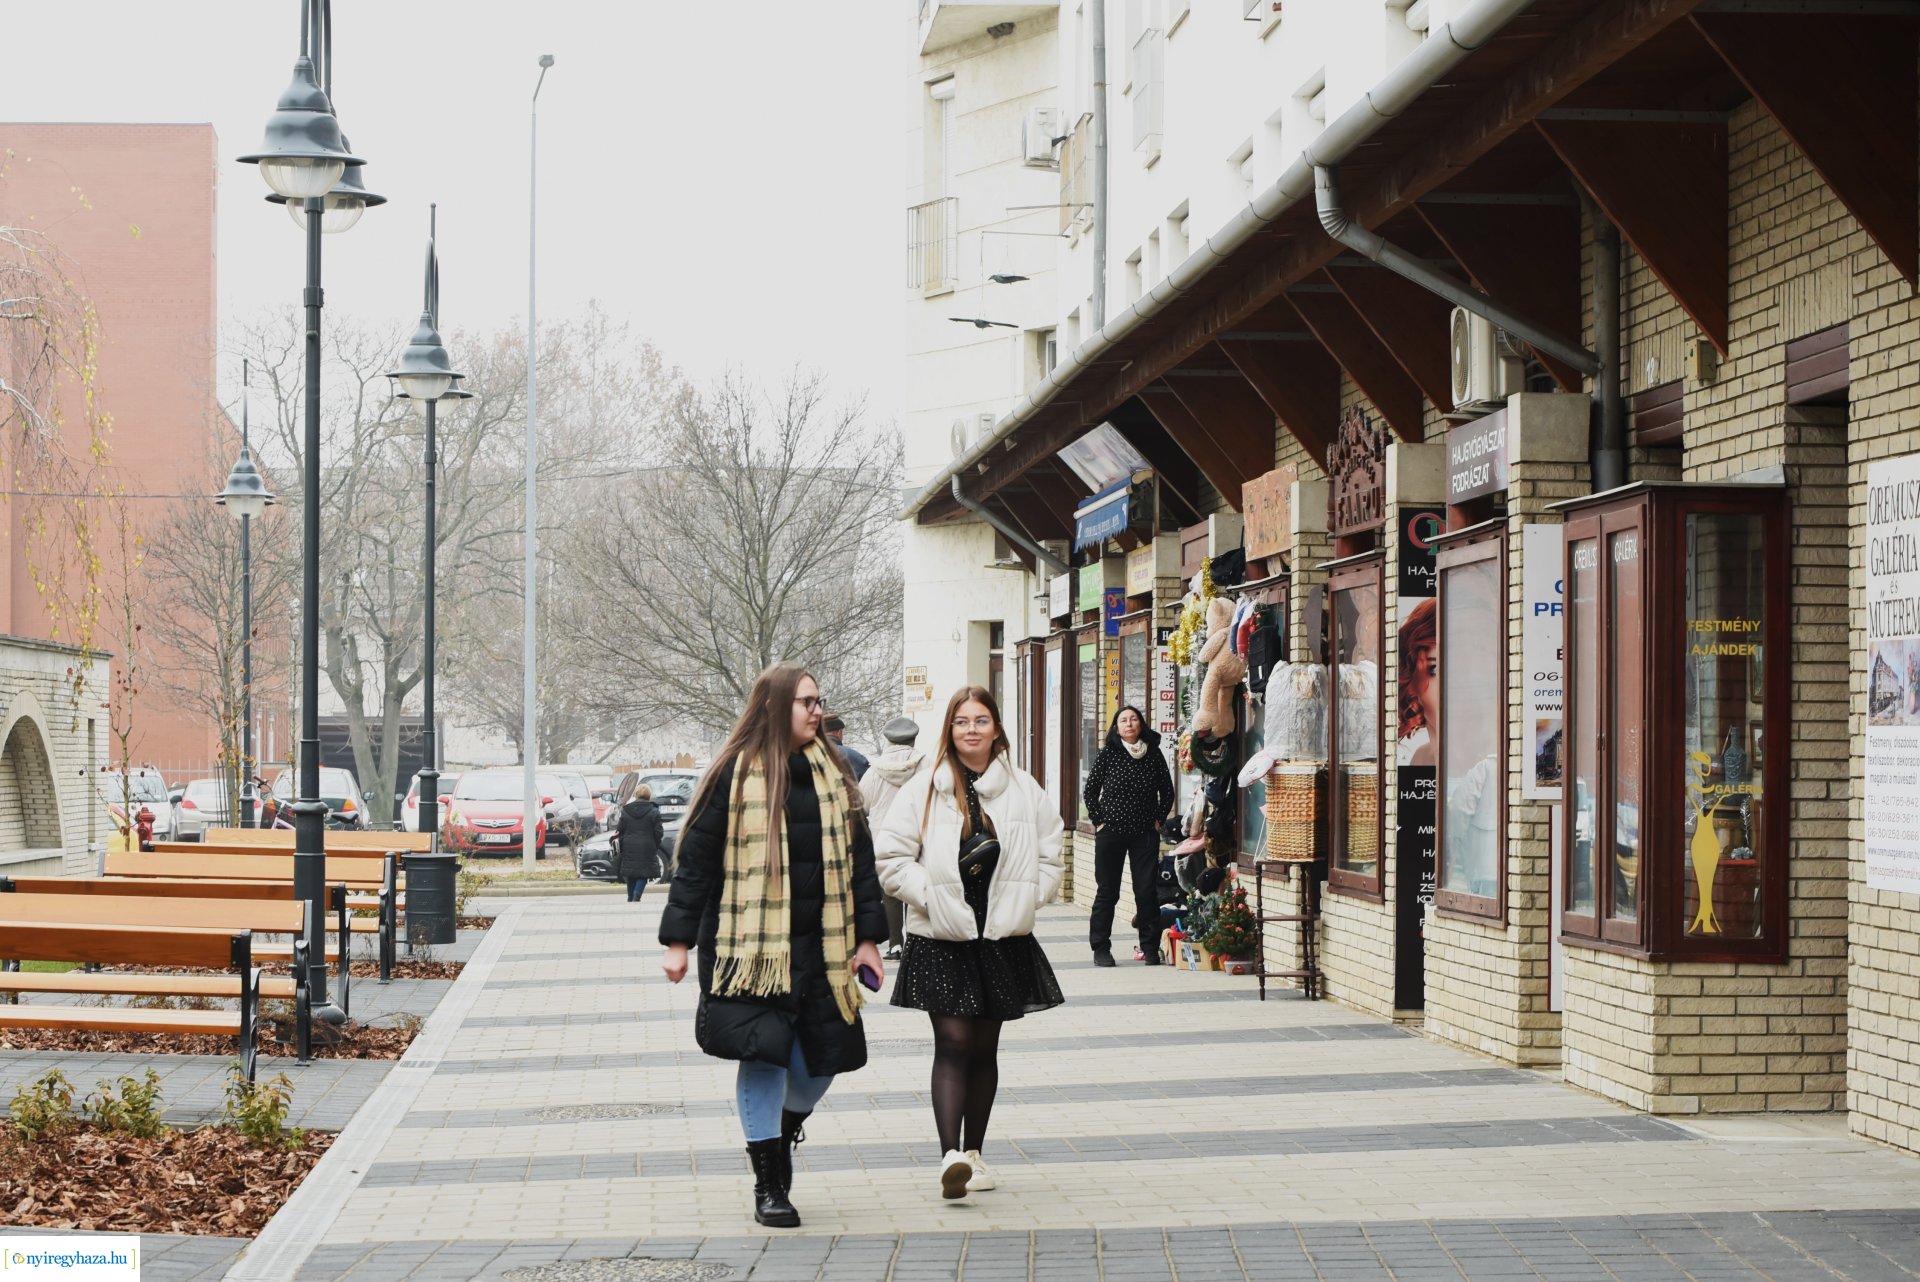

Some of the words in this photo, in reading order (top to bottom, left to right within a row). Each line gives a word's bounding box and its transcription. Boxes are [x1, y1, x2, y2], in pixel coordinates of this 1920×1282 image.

[1452, 427, 1506, 466] HAJGYÓGYÁSZAT
[1452, 462, 1490, 495] FODRÁSZAT
[1868, 476, 1920, 527] ORÉMUSZ
[1870, 527, 1919, 577] GALÉRIA
[1889, 576, 1899, 595] és
[1687, 616, 1761, 632] FESTMÉNY
[1691, 641, 1758, 656] AJÁNDEK
